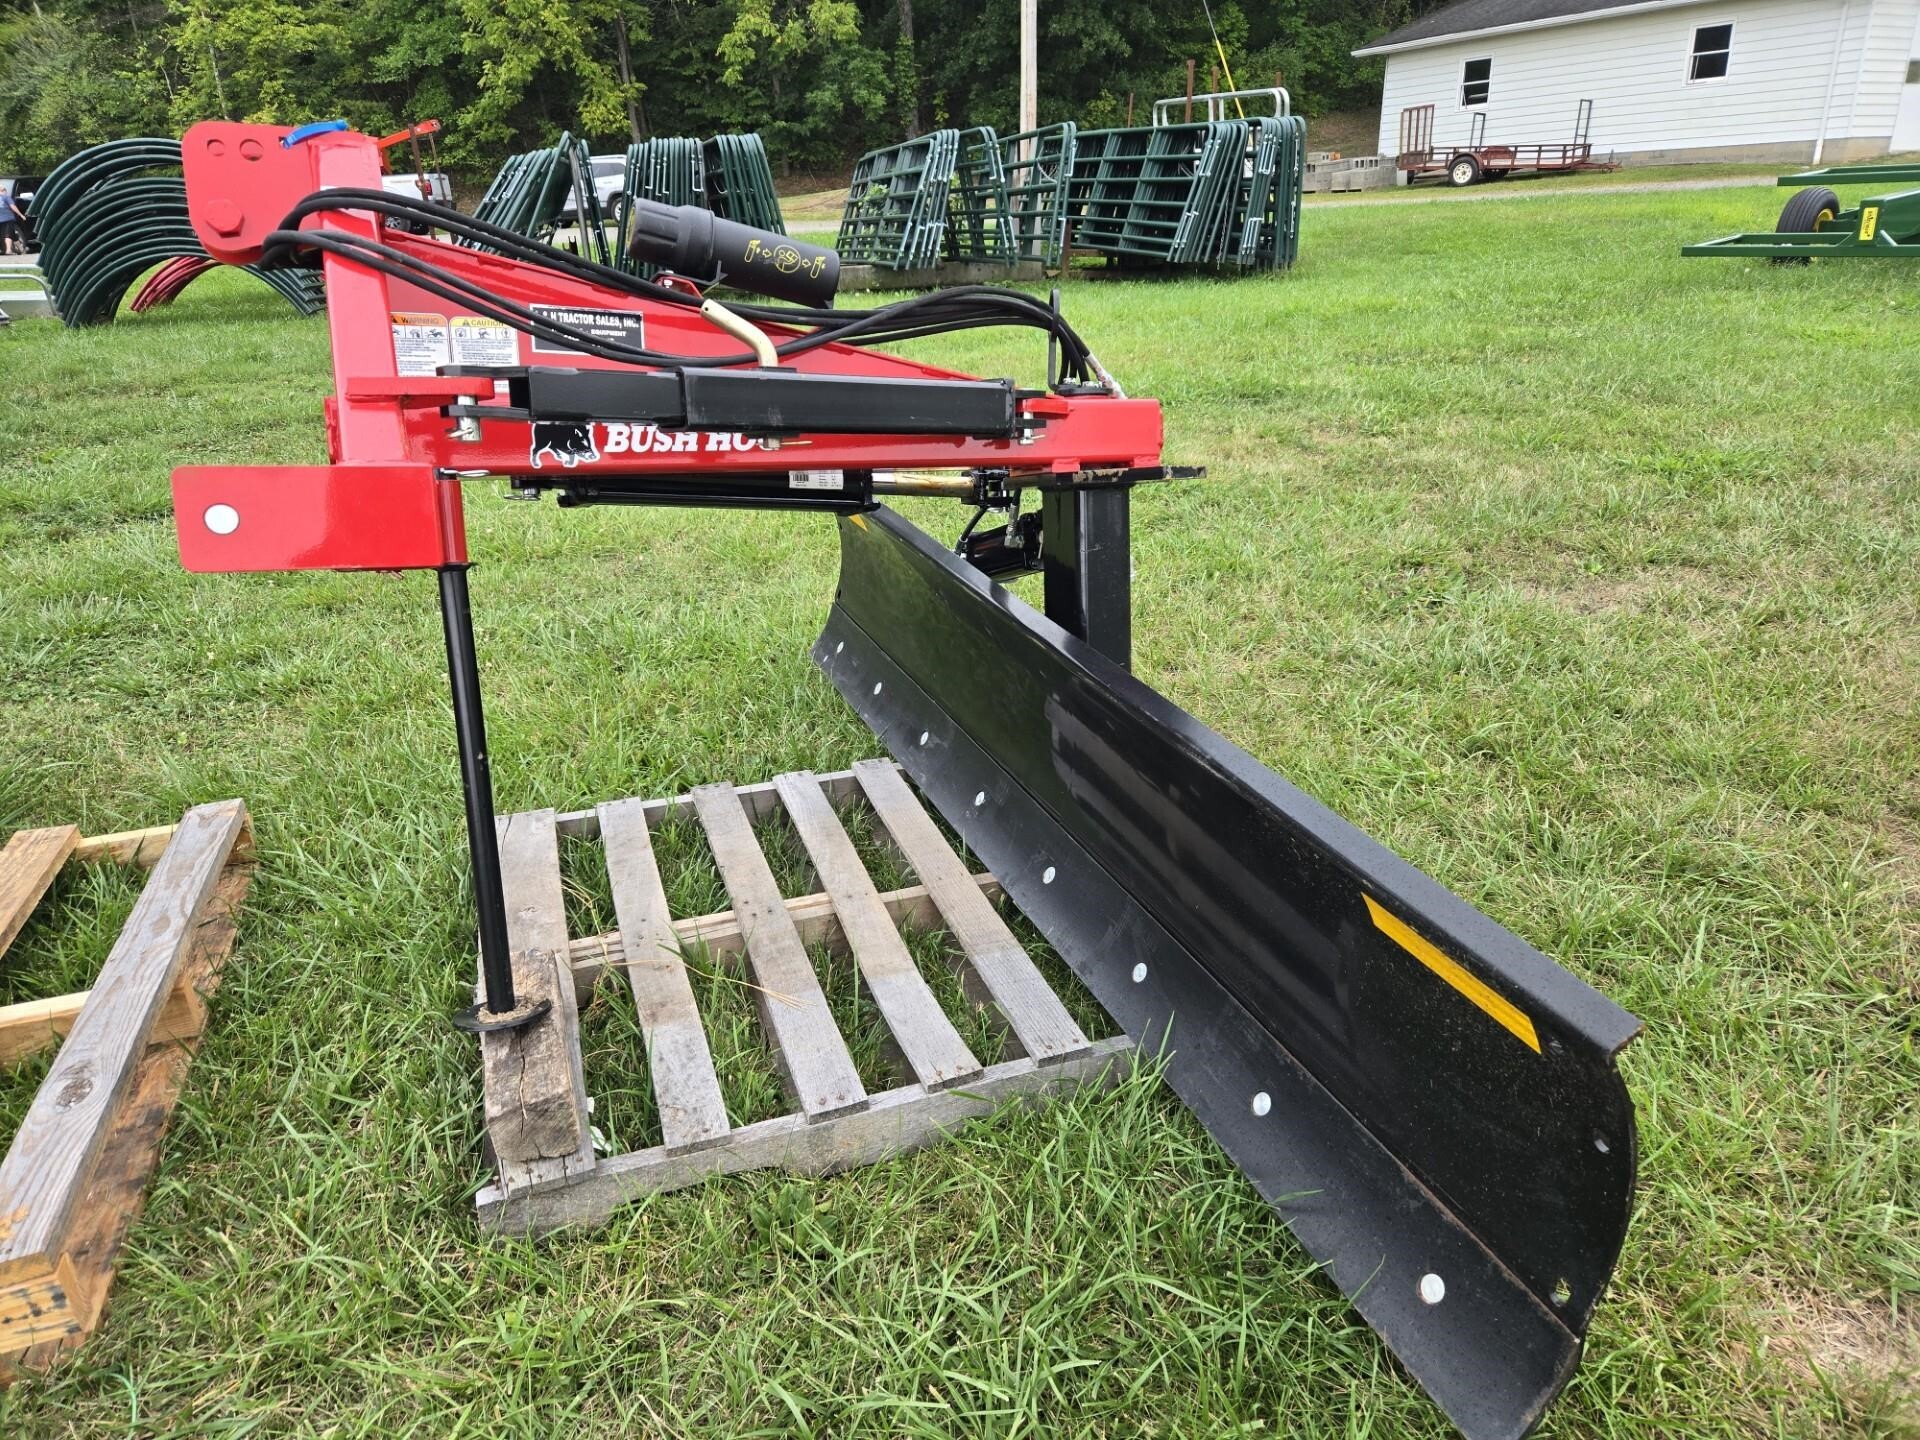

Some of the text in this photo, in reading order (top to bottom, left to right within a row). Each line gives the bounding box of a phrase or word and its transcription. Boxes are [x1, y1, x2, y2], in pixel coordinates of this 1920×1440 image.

[401, 317, 439, 325] WARNING
[471, 319, 504, 327] CAUTION
[558, 312, 594, 325] TRACTOR
[596, 315, 622, 329] SALES,
[603, 422, 780, 453] BUSH HO
